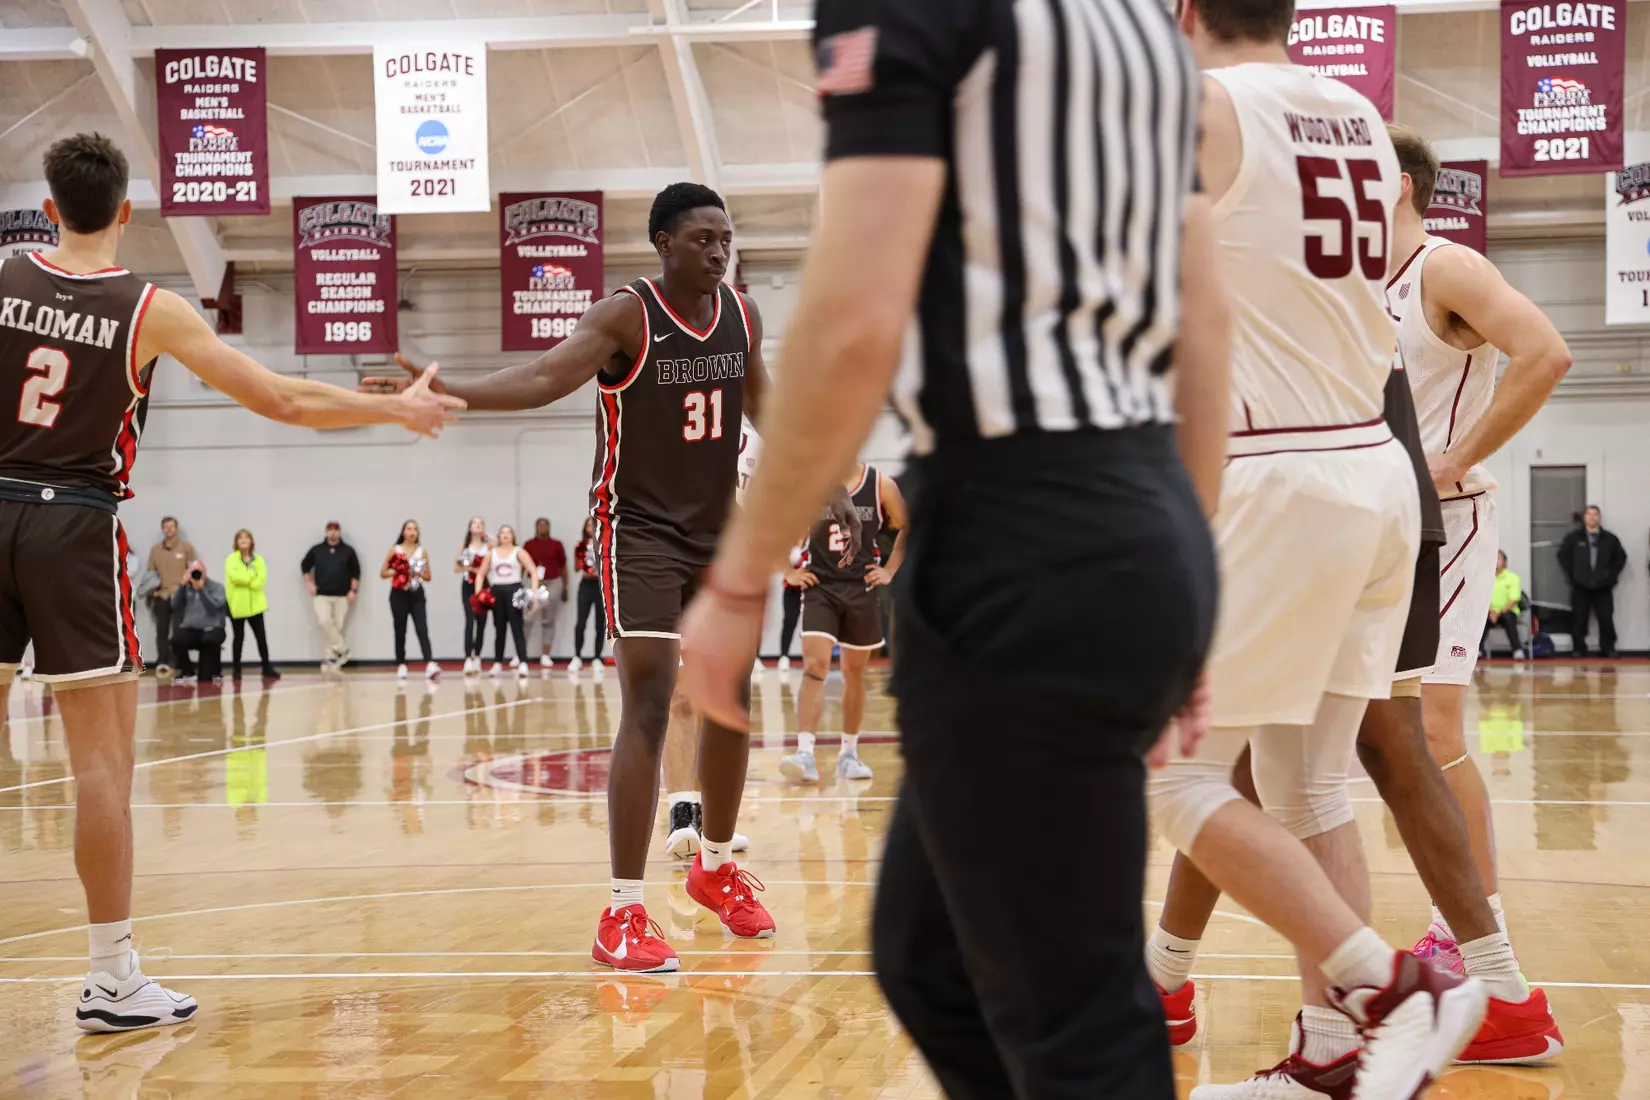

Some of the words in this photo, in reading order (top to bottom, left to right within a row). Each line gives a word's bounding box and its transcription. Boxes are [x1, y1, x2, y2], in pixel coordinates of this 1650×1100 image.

[1510, 3, 1616, 36] COLGATE
[1287, 15, 1385, 46] COLGATE
[1530, 32, 1595, 46] RAIDERS
[1302, 43, 1364, 56] RAIDERS
[385, 51, 475, 79] COLGATE
[1526, 51, 1599, 68] VOLLEYBALL
[165, 55, 257, 84] COLGATE
[183, 83, 240, 94] RAIDERS
[195, 96, 229, 109] MEN'S
[399, 103, 463, 115] BASKETBALL
[180, 107, 246, 120] BASKETBALL
[1517, 104, 1607, 121] TOURNAMENT
[1283, 112, 1373, 147] WOODWARD
[1517, 116, 1607, 135] CHAMPIONS
[1533, 136, 1590, 162] 2021
[174, 151, 254, 165] TOURNAMENT
[388, 158, 476, 172] TOURNAMENT
[175, 162, 254, 178] CHAMPIONS
[172, 180, 258, 203] 2020-21
[410, 178, 456, 197] 2021
[1295, 154, 1388, 282] 55
[310, 248, 381, 262] VOLLEYBALL
[516, 244, 588, 258] VOLLEYBALL
[315, 271, 378, 287] REGULAR
[320, 285, 373, 300] SEASON
[512, 289, 593, 304] TOURNAMENT
[307, 299, 386, 315] CHAMPIONS
[0, 297, 120, 350] KLOMAN
[324, 320, 373, 343] 1996
[656, 351, 745, 385] BROWN
[18, 346, 72, 429] 2
[681, 387, 724, 443] 31
